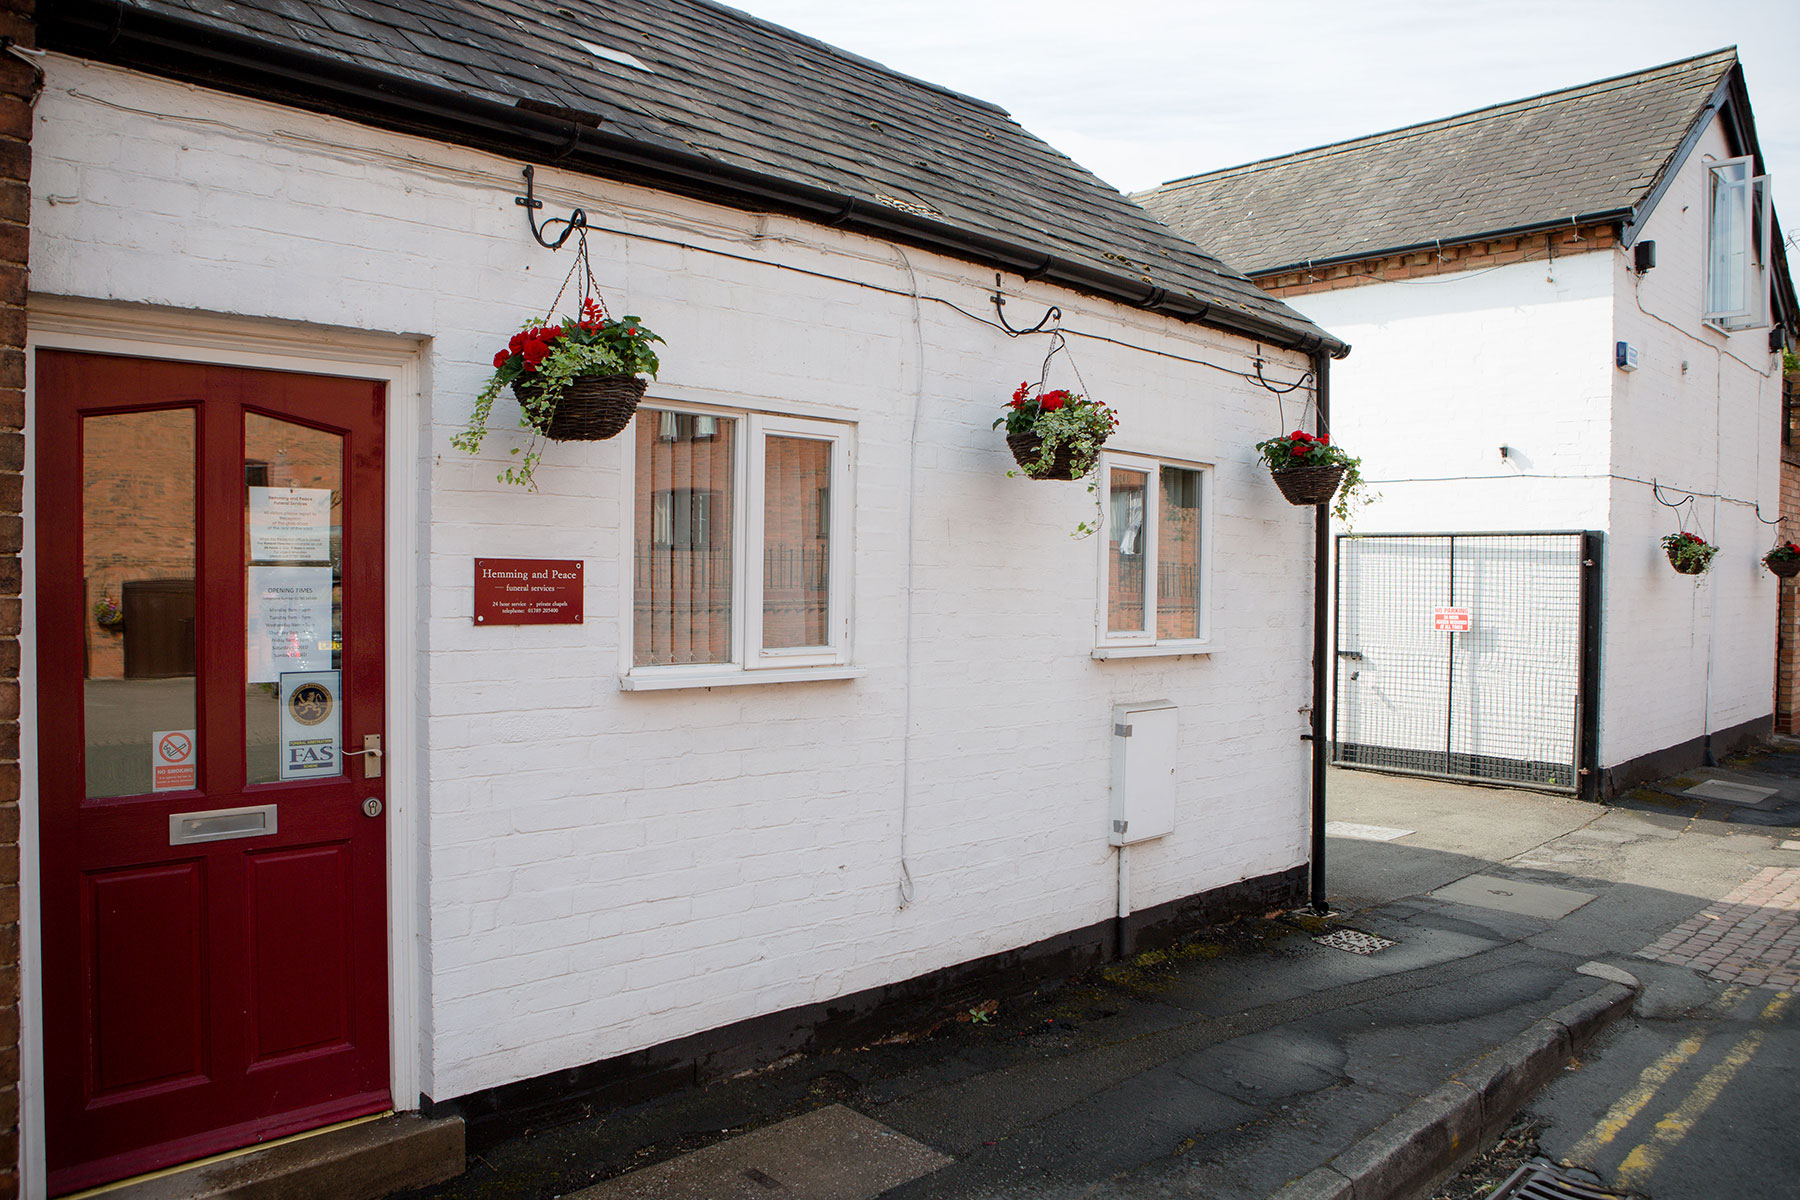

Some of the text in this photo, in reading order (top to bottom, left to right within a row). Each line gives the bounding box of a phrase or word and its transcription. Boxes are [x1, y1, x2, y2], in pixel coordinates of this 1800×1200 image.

[482, 568, 577, 580] Hemming and Peace
[506, 584, 555, 592] funeral services
[289, 746, 334, 763] FAS
